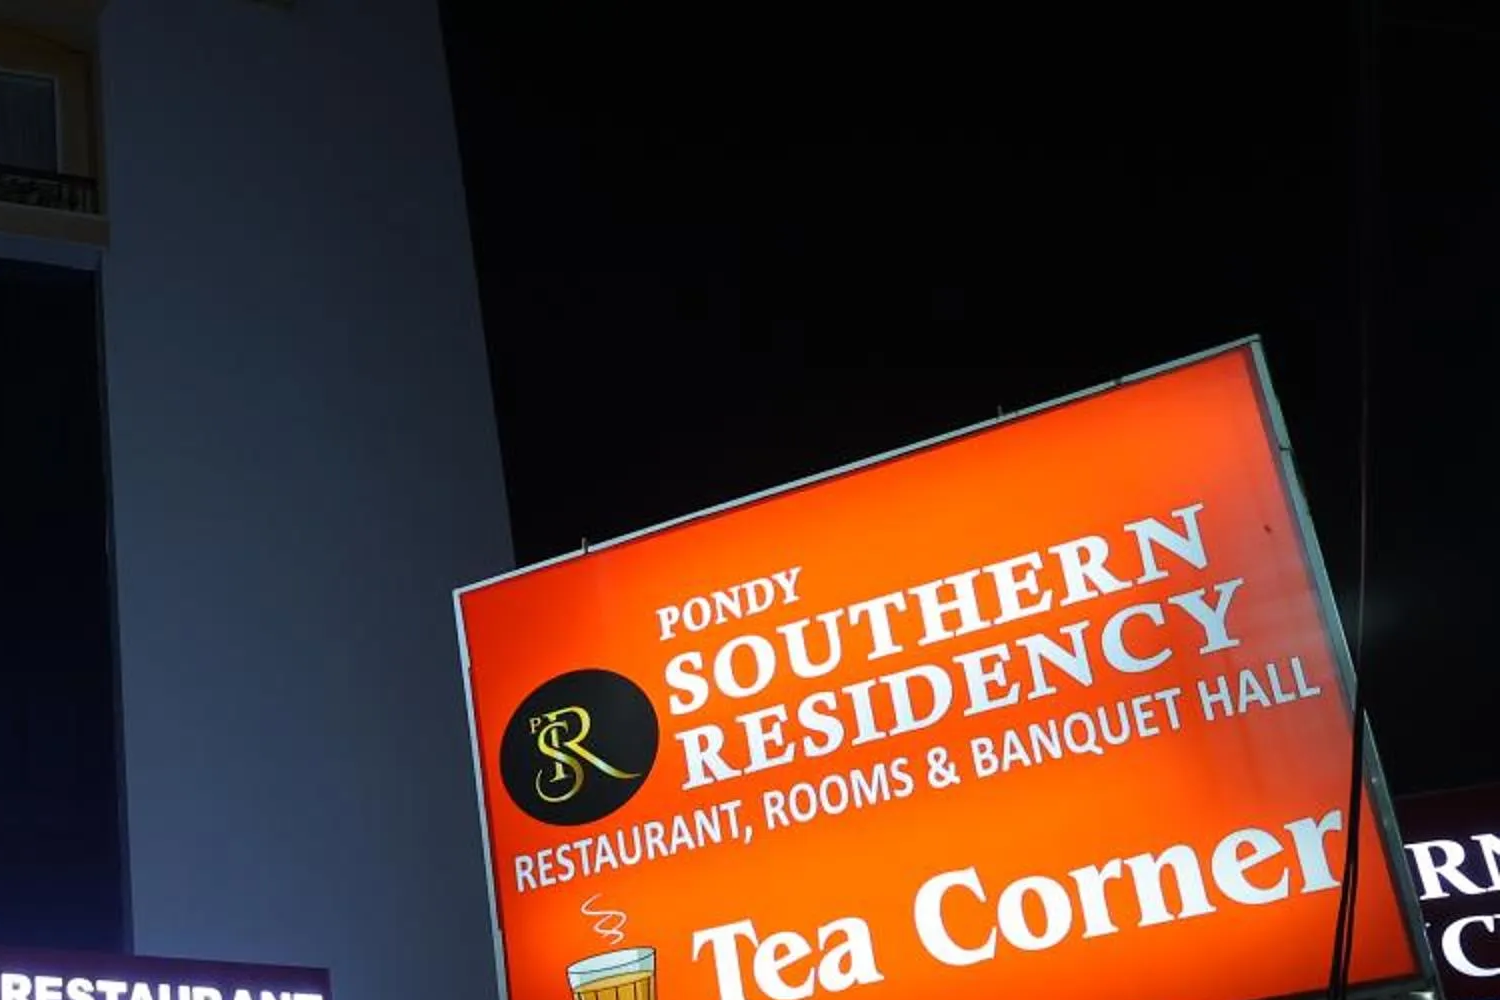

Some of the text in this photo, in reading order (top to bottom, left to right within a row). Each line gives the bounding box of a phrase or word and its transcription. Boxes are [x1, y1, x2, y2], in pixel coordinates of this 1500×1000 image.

[656, 566, 802, 641] PONDY
[665, 503, 1208, 715] SOUTHERN
[675, 577, 1245, 790] RESIDENCY
[514, 656, 1322, 893] RESTAURANT, ROOMS & BANQUET HALL
[912, 809, 1343, 967] Corner
